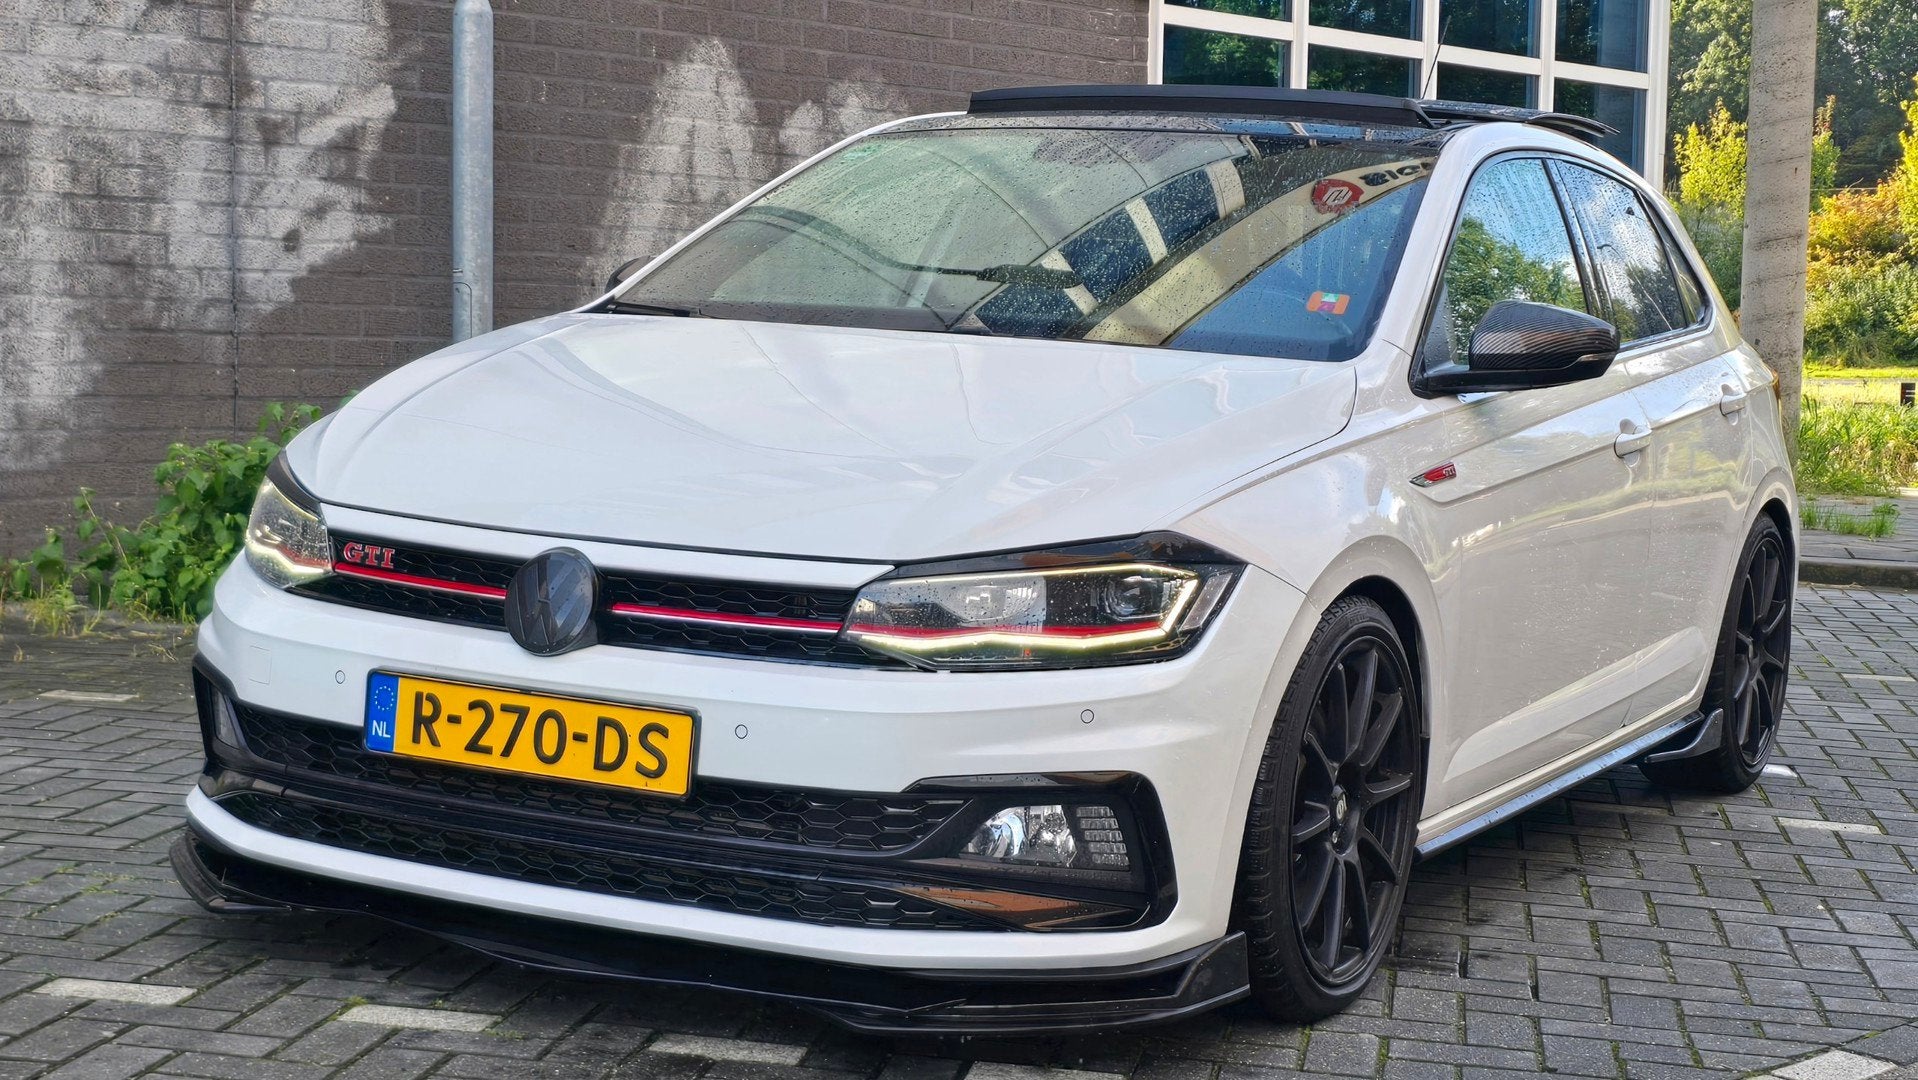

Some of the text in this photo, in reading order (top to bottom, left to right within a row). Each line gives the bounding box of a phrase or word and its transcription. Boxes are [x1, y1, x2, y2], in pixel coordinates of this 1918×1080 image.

[343, 541, 396, 569] GTI
[371, 719, 391, 739] NL
[411, 690, 670, 780] R-270-DS
